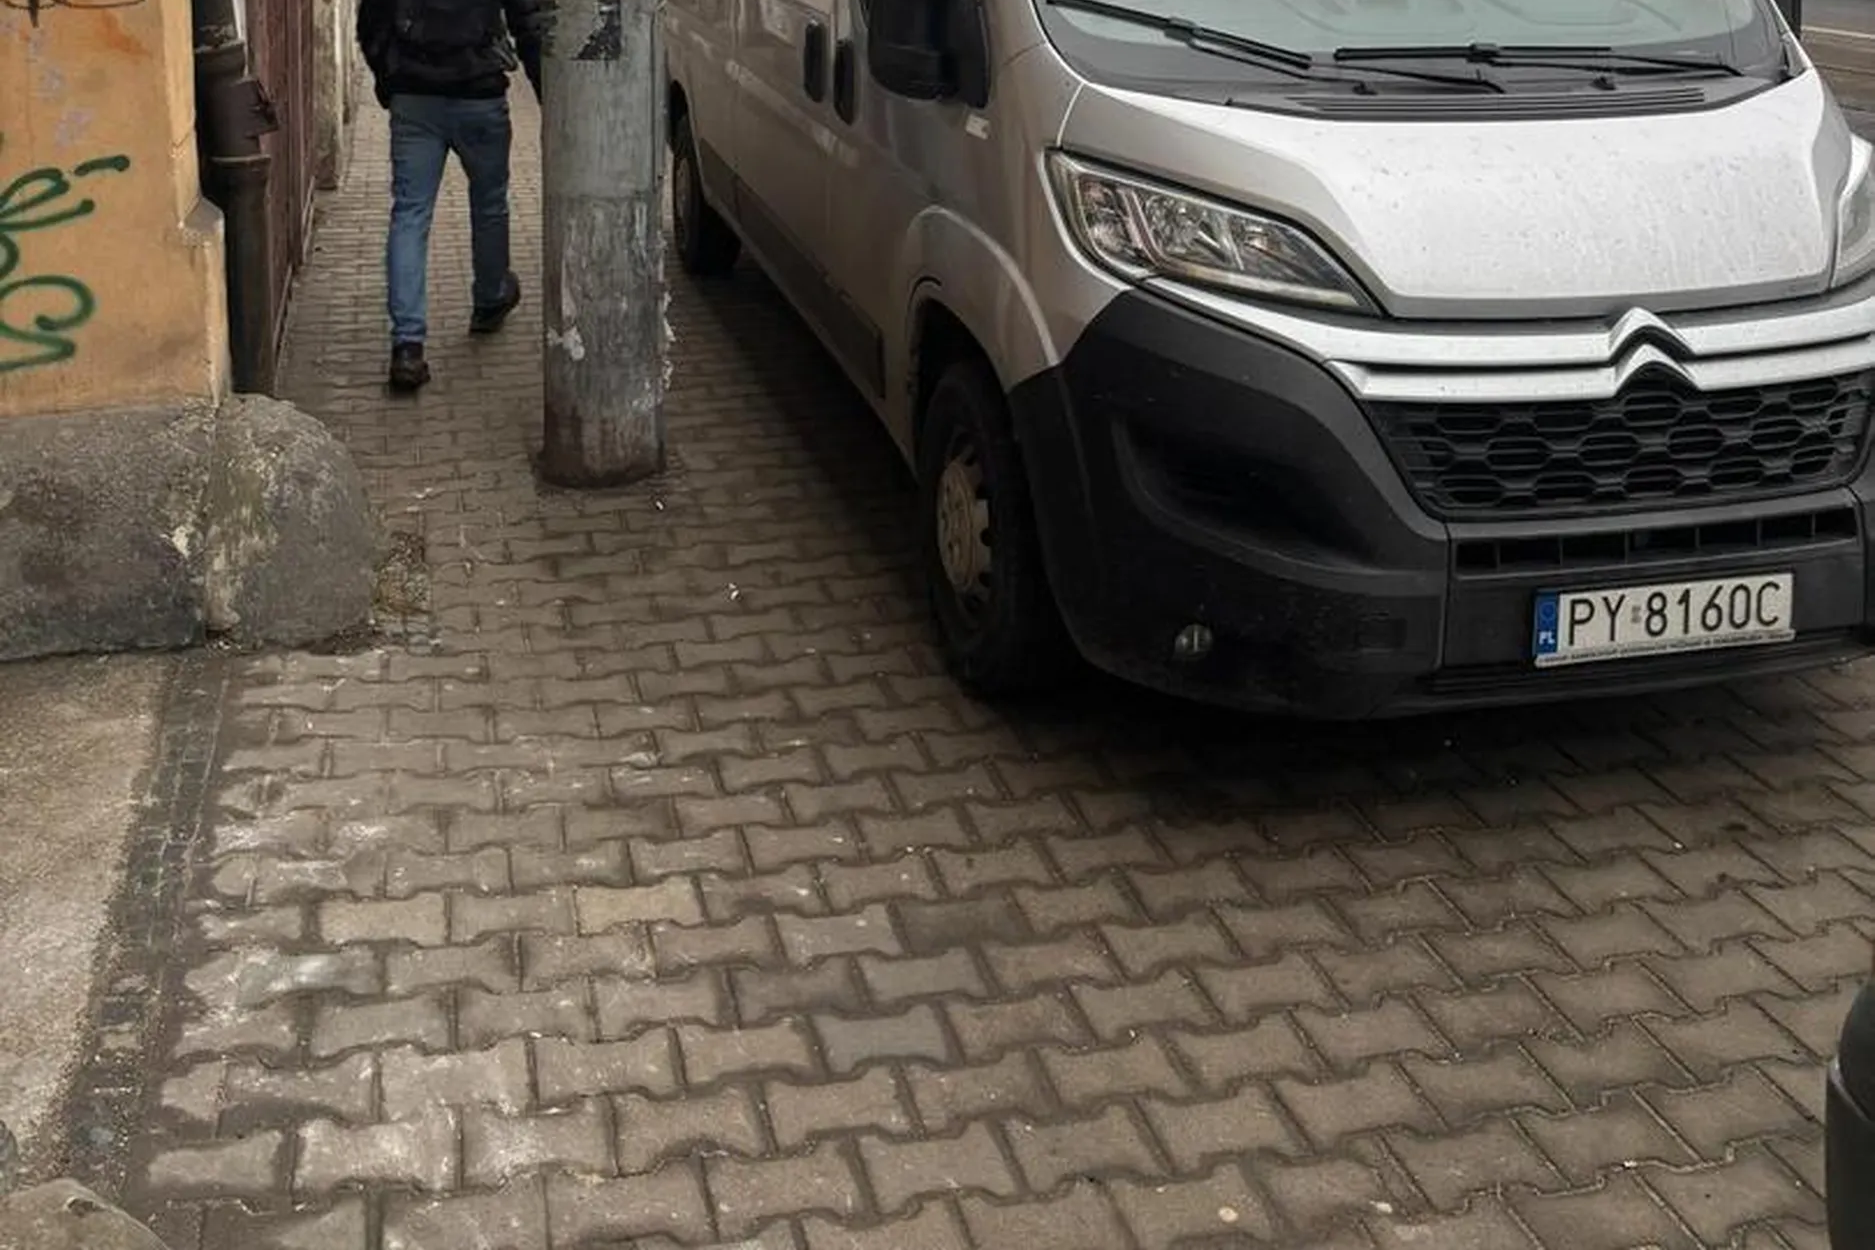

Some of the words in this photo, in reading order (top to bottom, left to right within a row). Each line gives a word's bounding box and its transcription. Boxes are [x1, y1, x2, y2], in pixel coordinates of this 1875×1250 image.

[1568, 594, 1626, 647] PY
[1645, 581, 1781, 638] 8160C
[1538, 630, 1556, 646] PL
